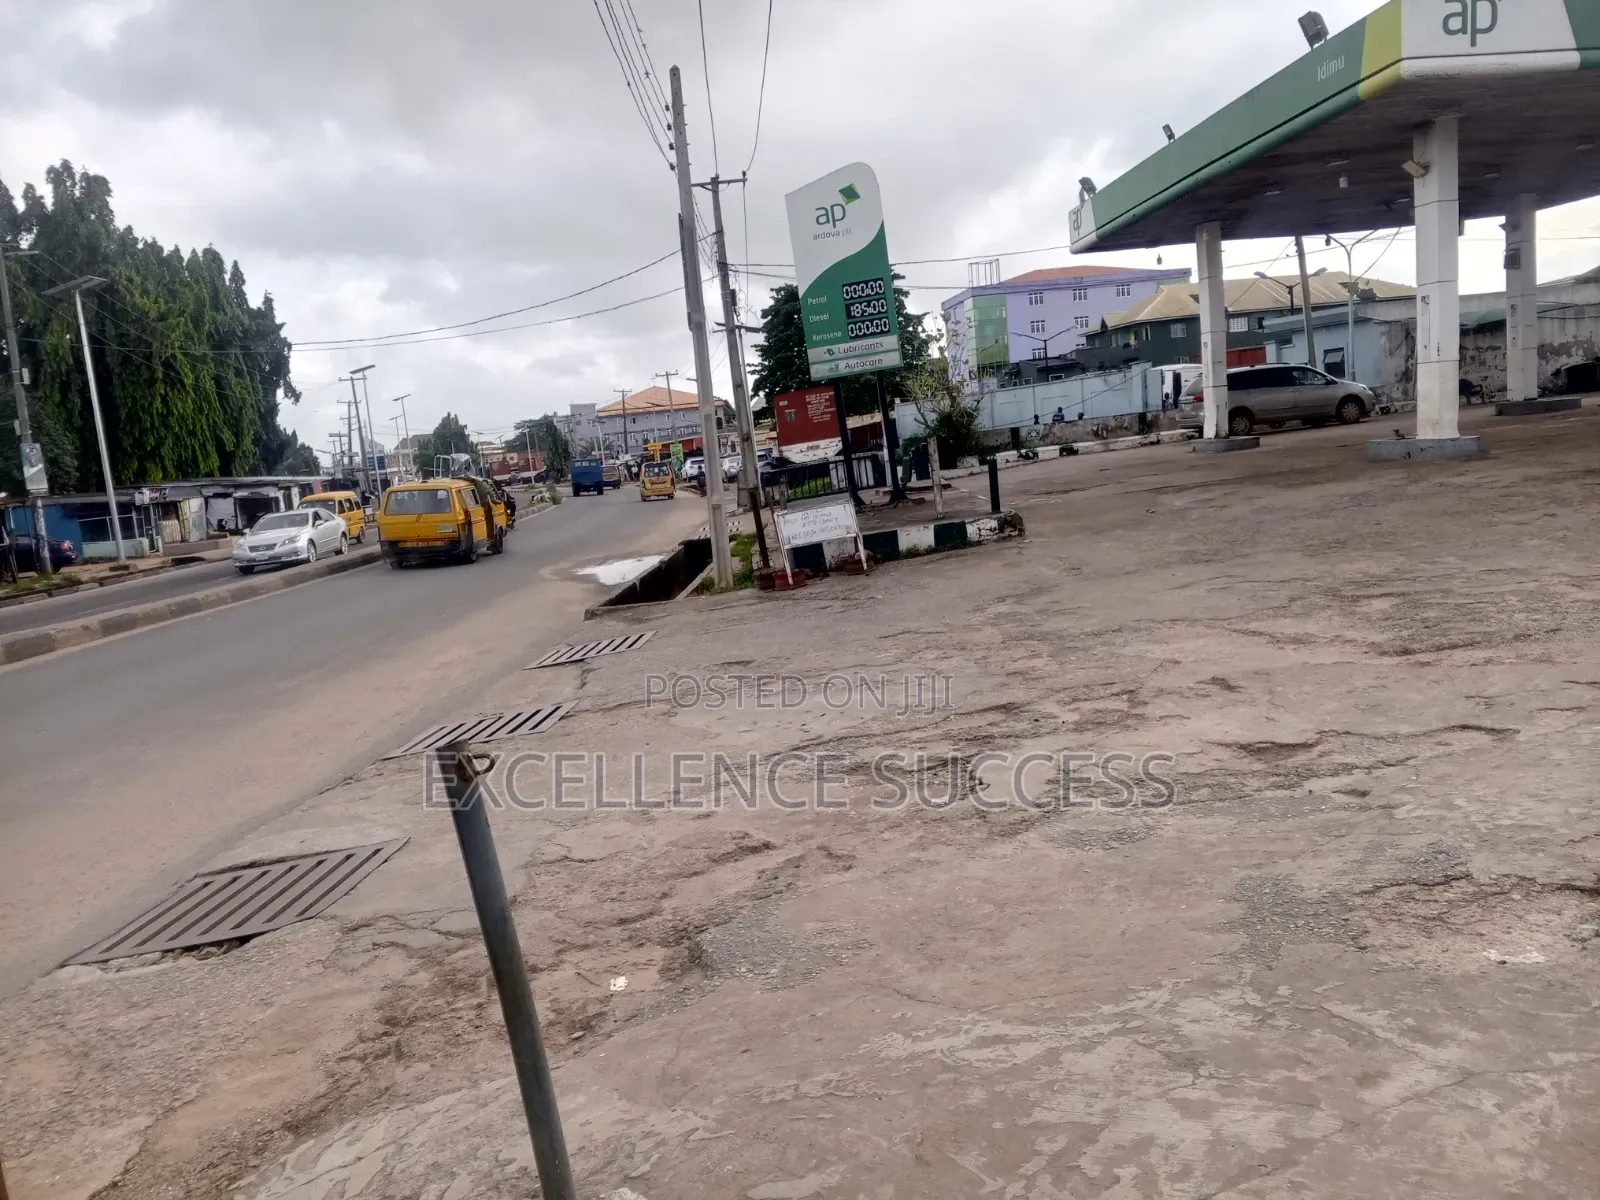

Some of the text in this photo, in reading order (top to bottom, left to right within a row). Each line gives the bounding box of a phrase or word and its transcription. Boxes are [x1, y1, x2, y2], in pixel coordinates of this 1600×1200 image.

[1442, 0, 1499, 48] ap
[1317, 55, 1345, 82] Idimu
[814, 203, 847, 229] ap
[1072, 208, 1083, 237] ap
[812, 228, 853, 241] ardova plc
[807, 295, 828, 306] Petrol
[809, 312, 830, 323] Diesel
[812, 331, 842, 342] Kerosene
[837, 341, 884, 355] Lubricants
[843, 358, 883, 370] Autocare
